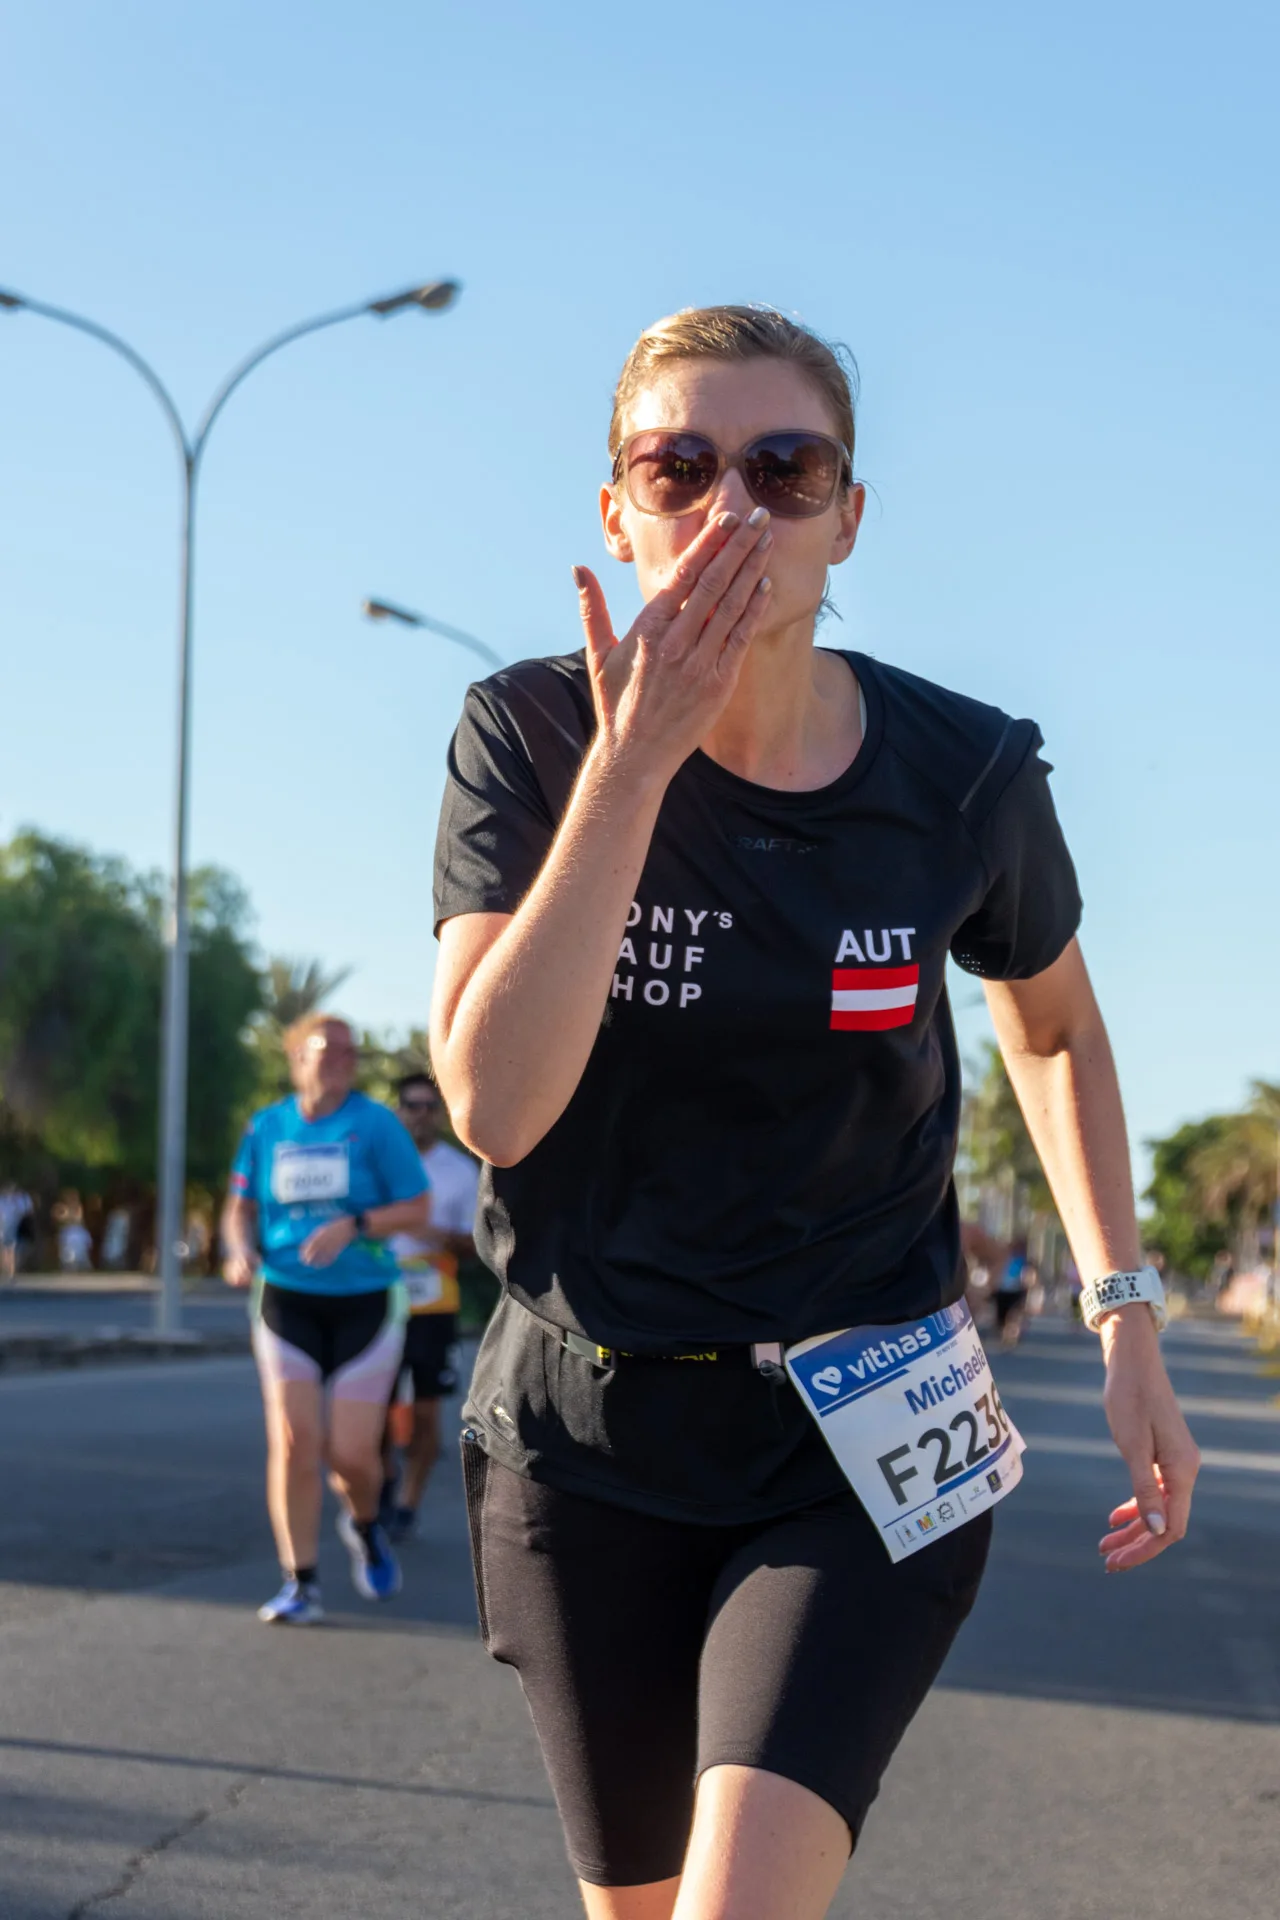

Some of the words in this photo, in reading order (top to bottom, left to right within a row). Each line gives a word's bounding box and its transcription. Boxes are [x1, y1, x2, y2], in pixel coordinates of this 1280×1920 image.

[732, 835, 796, 852] RAFT
[617, 937, 705, 972] AUF
[835, 927, 916, 963] AUT
[612, 973, 702, 1008] HOP
[847, 1325, 931, 1380] vithas
[904, 1344, 986, 1415] Michaela
